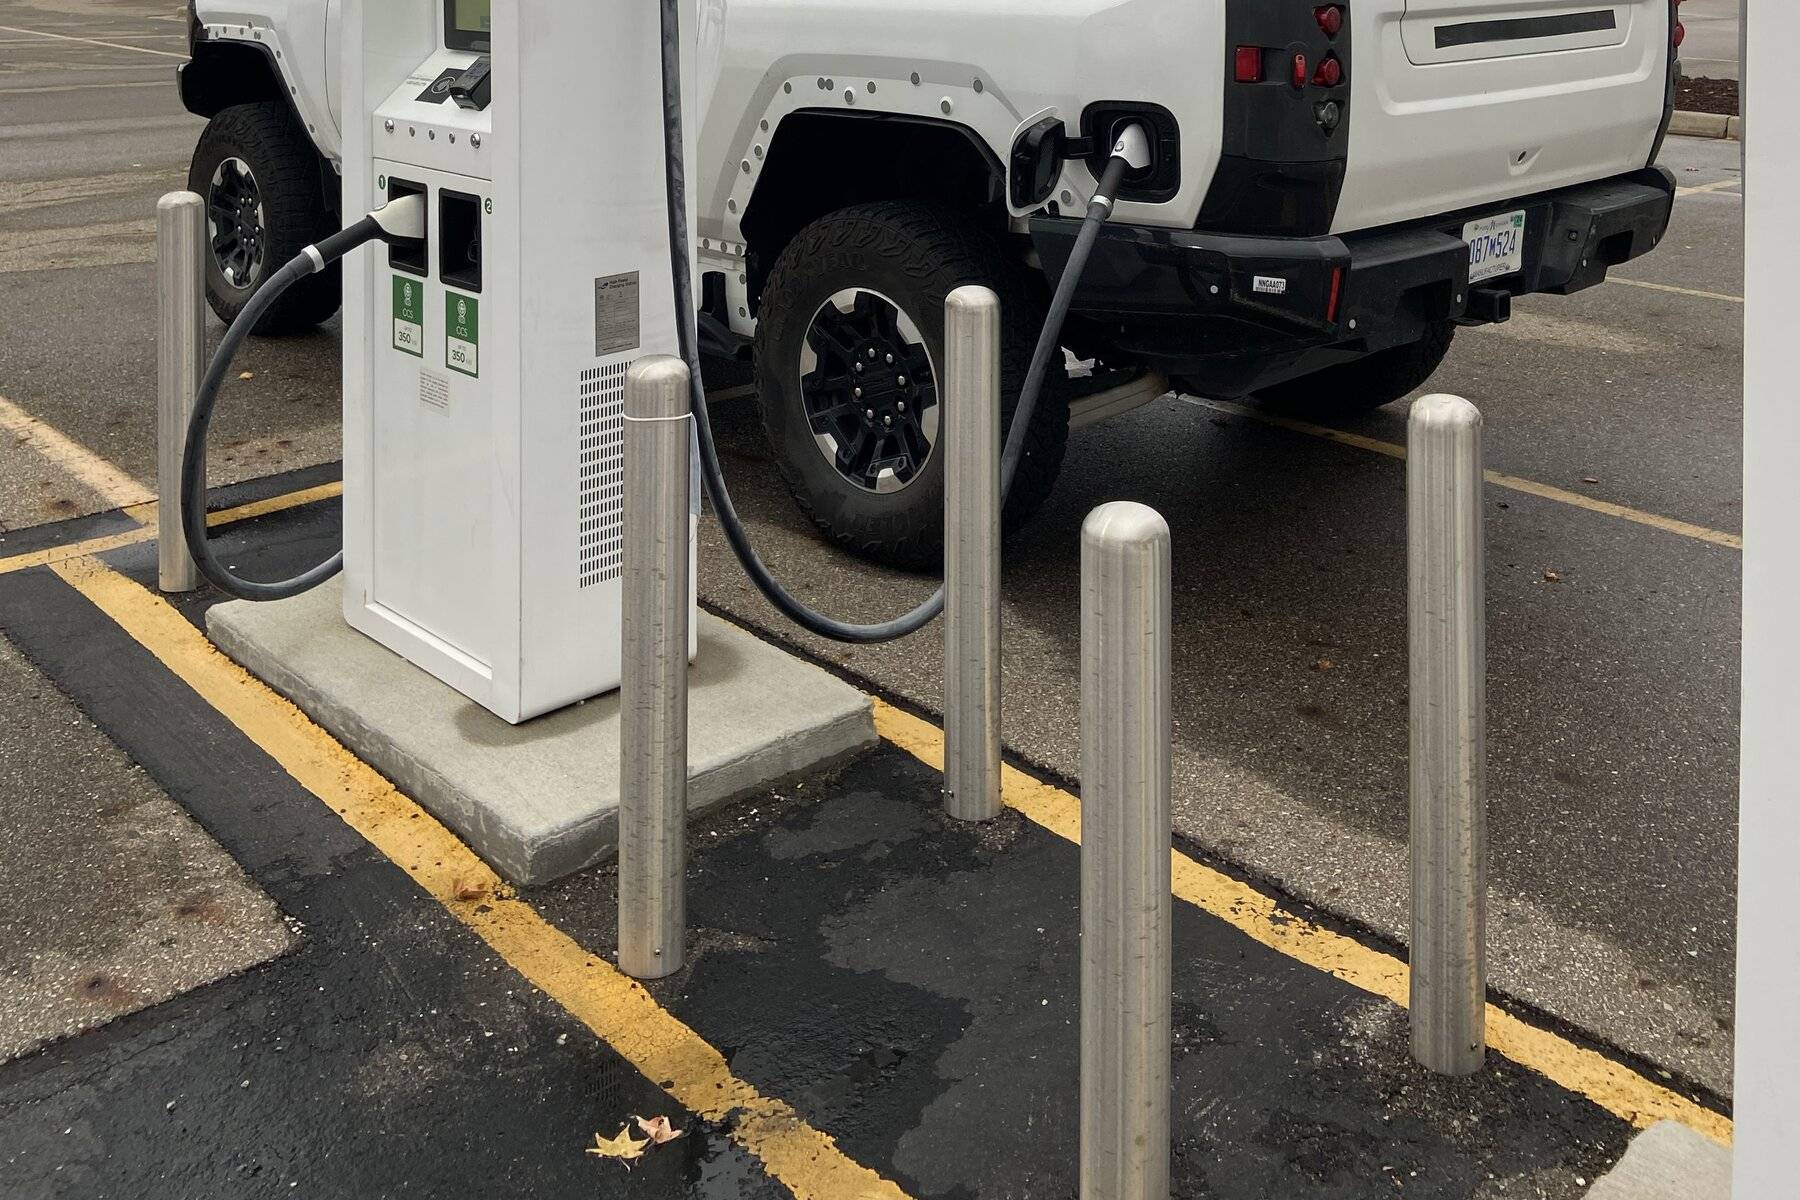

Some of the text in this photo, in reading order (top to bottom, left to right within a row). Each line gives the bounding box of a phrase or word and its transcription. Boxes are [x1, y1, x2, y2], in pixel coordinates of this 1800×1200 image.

[402, 308, 413, 319] CCS
[456, 325, 468, 337] CCS
[398, 331, 411, 344] 350
[452, 349, 465, 363] 350
